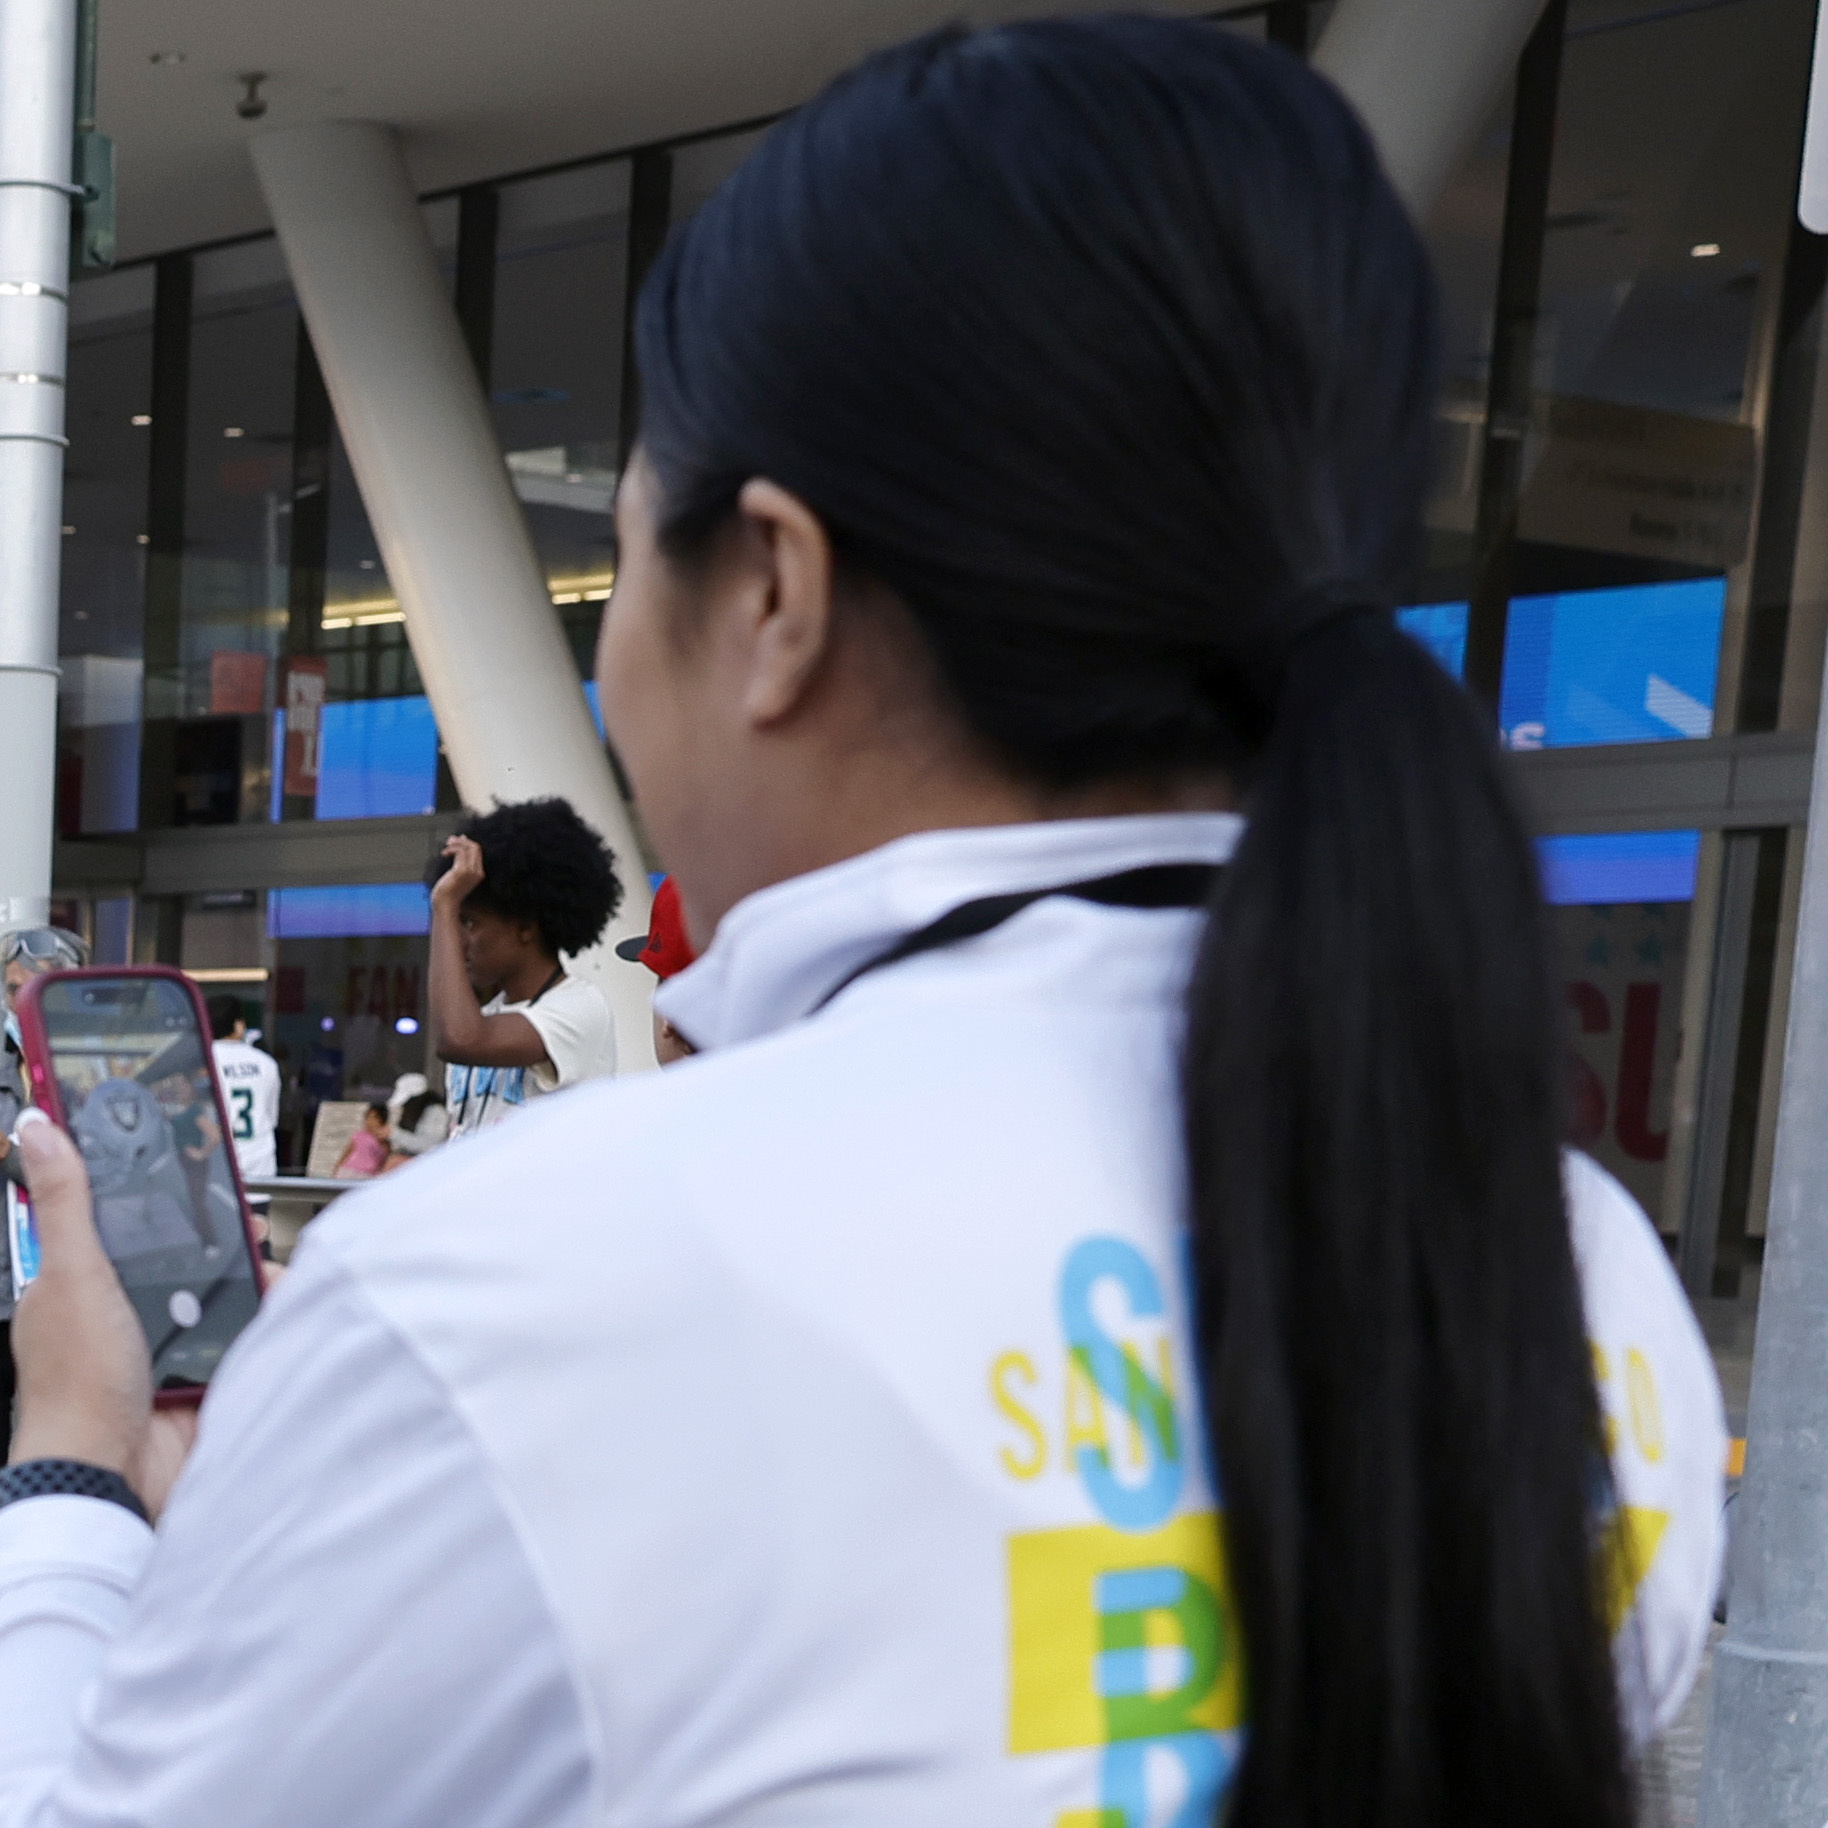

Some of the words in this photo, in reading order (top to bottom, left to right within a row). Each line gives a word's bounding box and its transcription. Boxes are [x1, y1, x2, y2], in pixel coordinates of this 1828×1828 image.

[223, 1062, 260, 1077] WILSON
[231, 1088, 253, 1139] 3
[988, 1336, 1181, 1481] SAN
